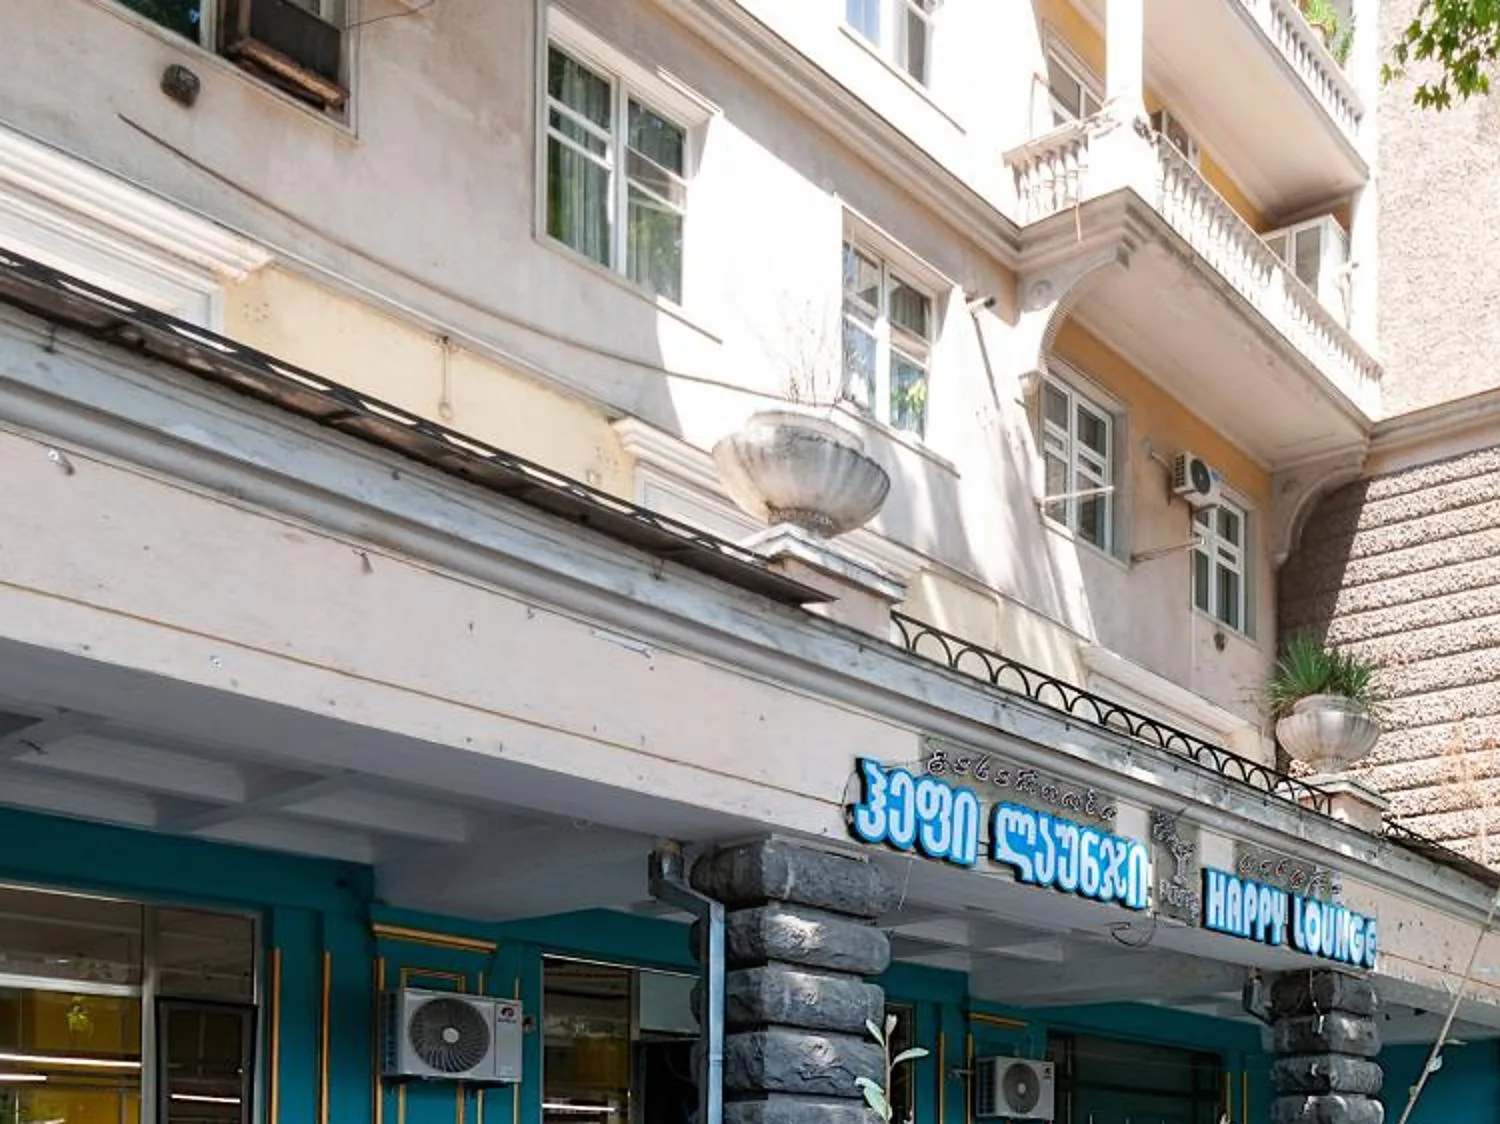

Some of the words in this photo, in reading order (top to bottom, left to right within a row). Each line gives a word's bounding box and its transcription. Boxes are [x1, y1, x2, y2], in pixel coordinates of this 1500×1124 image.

[855, 759, 979, 867] ჰეფი
[994, 803, 1149, 910] ლაუნჯი
[1204, 867, 1287, 946] HAPPY
[1291, 893, 1377, 970] LOUNGE
